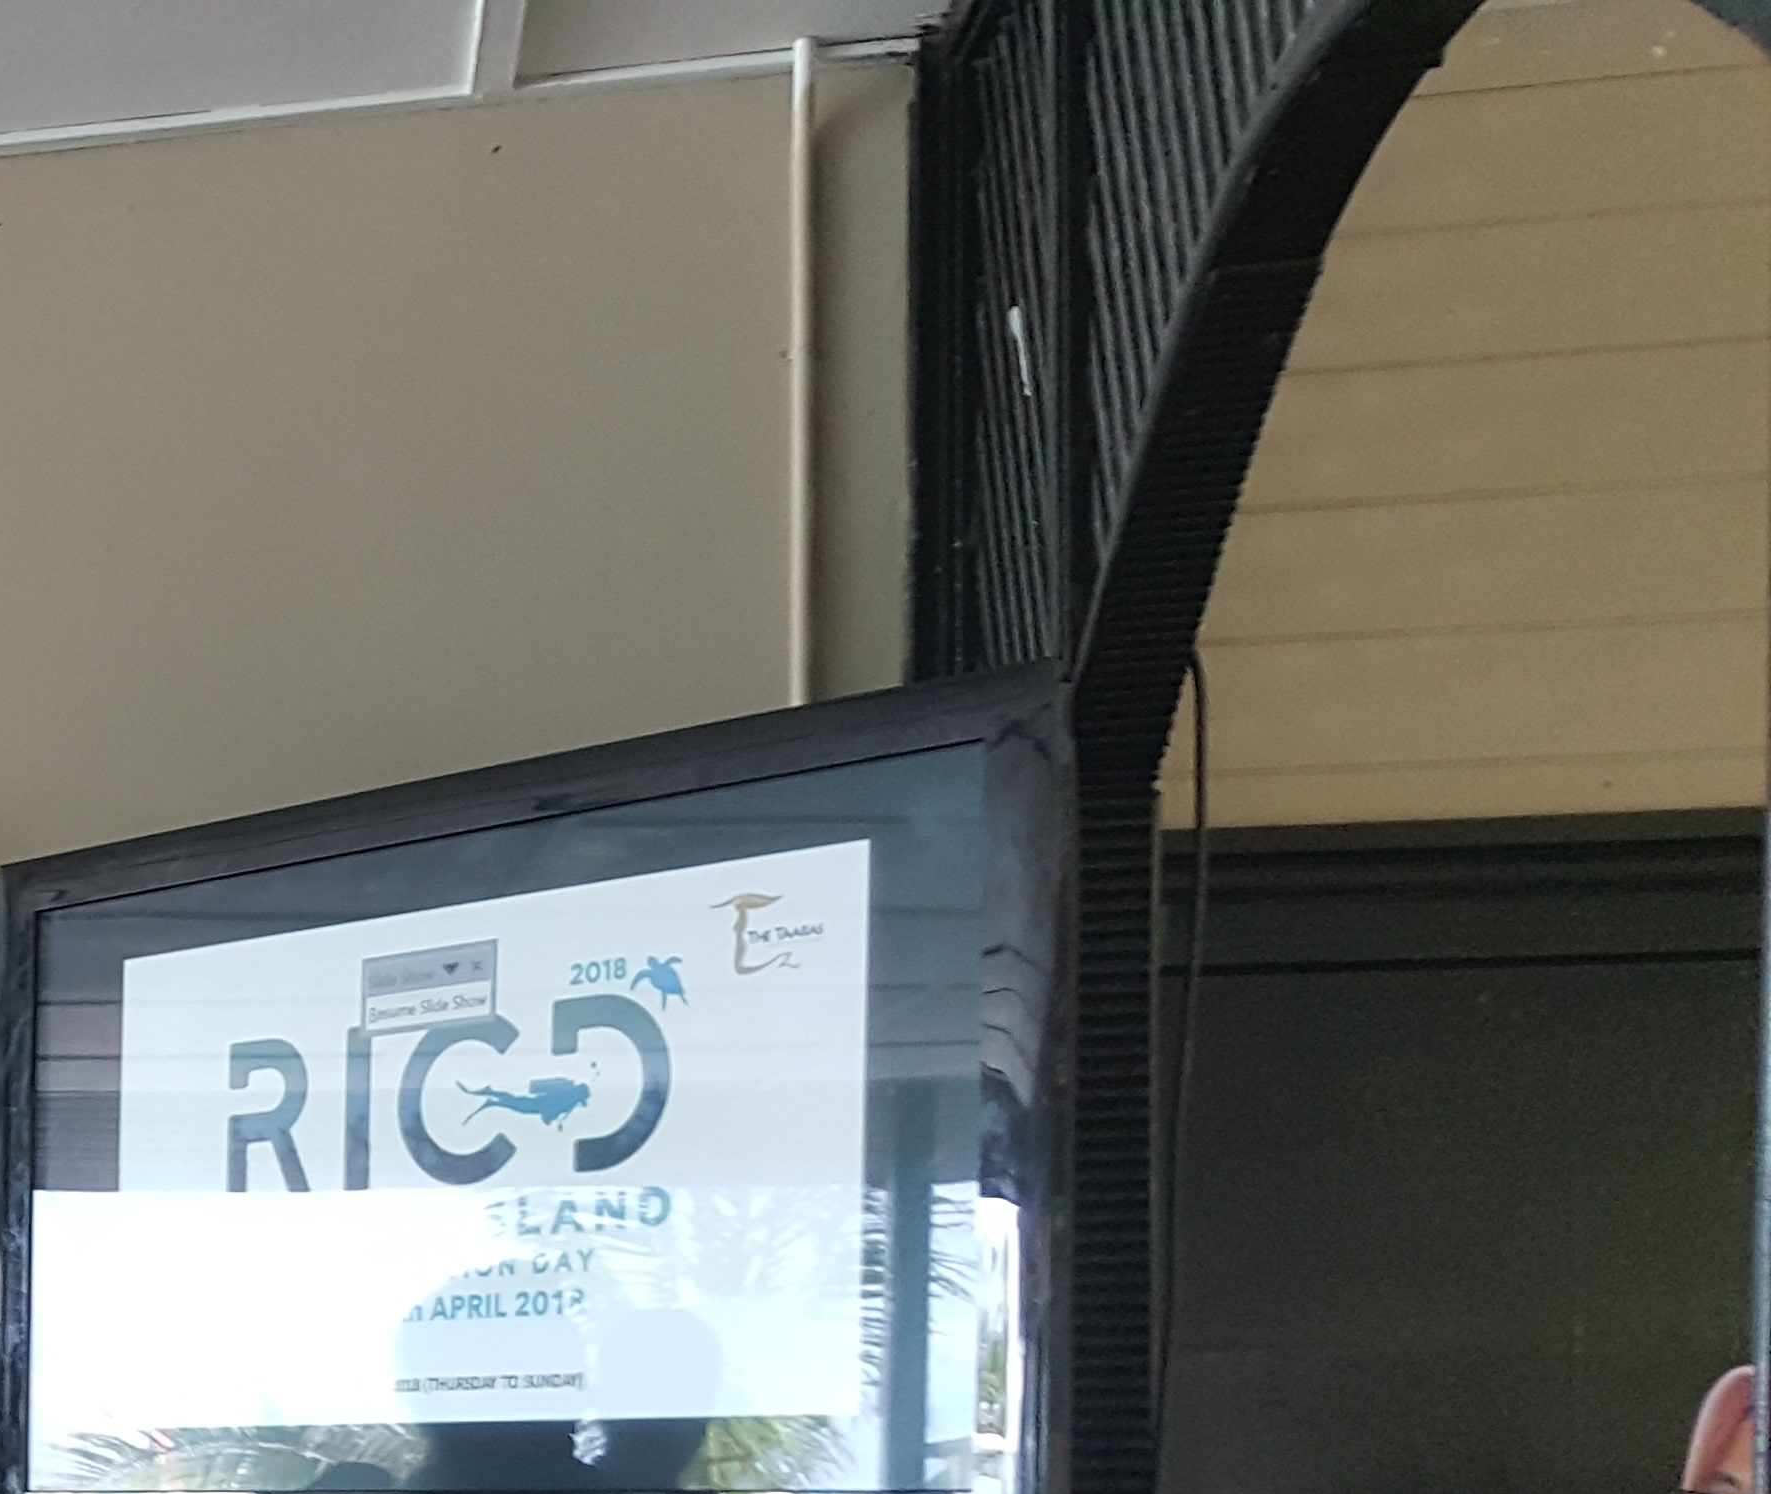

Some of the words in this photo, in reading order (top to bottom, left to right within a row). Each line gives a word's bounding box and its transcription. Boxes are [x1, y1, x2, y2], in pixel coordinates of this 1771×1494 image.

[569, 956, 627, 986] 2018
[368, 1006, 416, 1024] Resume
[420, 998, 450, 1015] Slide
[452, 994, 488, 1011] Show
[226, 993, 673, 1193] RICD
[531, 1249, 595, 1275] DAY
[429, 1293, 508, 1321] APRIL
[499, 1375, 518, 1389] TO
